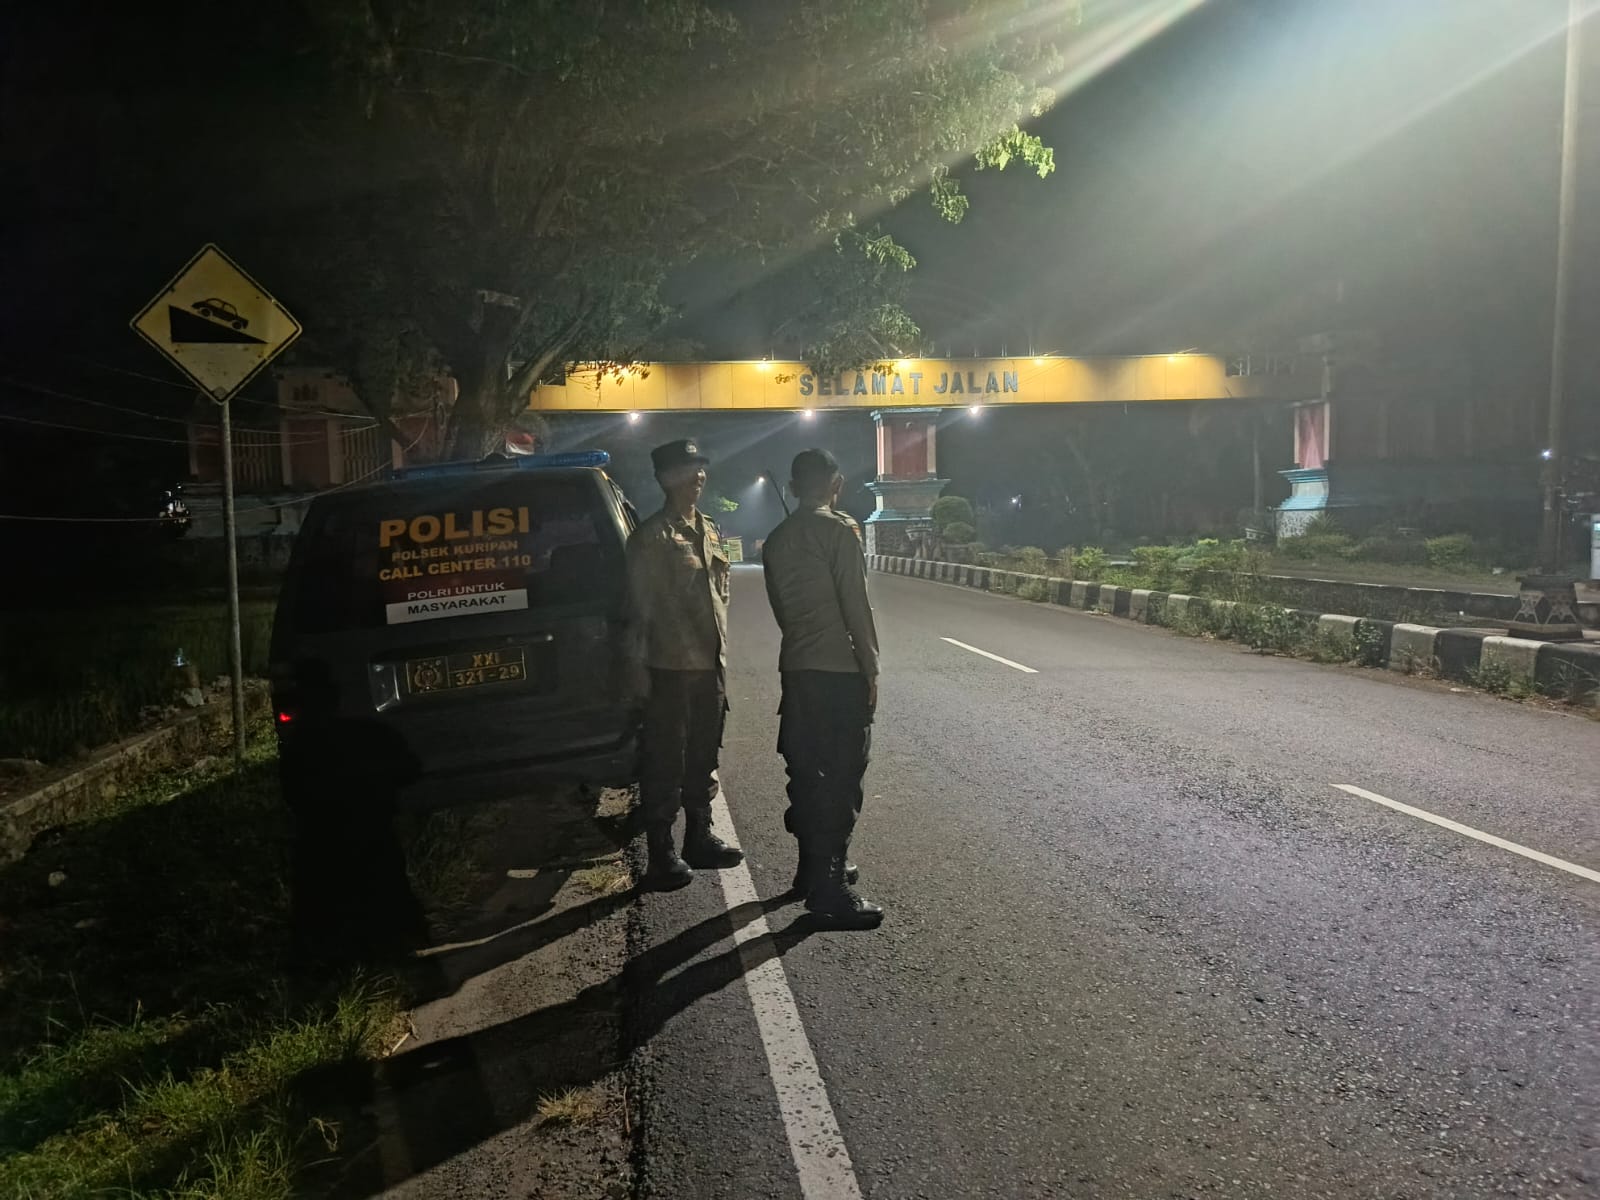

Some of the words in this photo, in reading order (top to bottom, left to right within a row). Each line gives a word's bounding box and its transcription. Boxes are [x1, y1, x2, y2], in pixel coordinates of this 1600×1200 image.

[799, 371, 923, 396] SELAMAT
[933, 371, 1018, 394] JALAN
[379, 507, 530, 548] POLISI
[392, 546, 449, 562] POLSEK
[454, 540, 518, 555] KURIPAN
[379, 565, 424, 581] CALL
[428, 558, 496, 575] CENTER
[502, 554, 531, 567] 110
[407, 588, 451, 600] POLRI
[455, 582, 505, 595] UNTUK
[408, 595, 507, 615] MASYARAKAT
